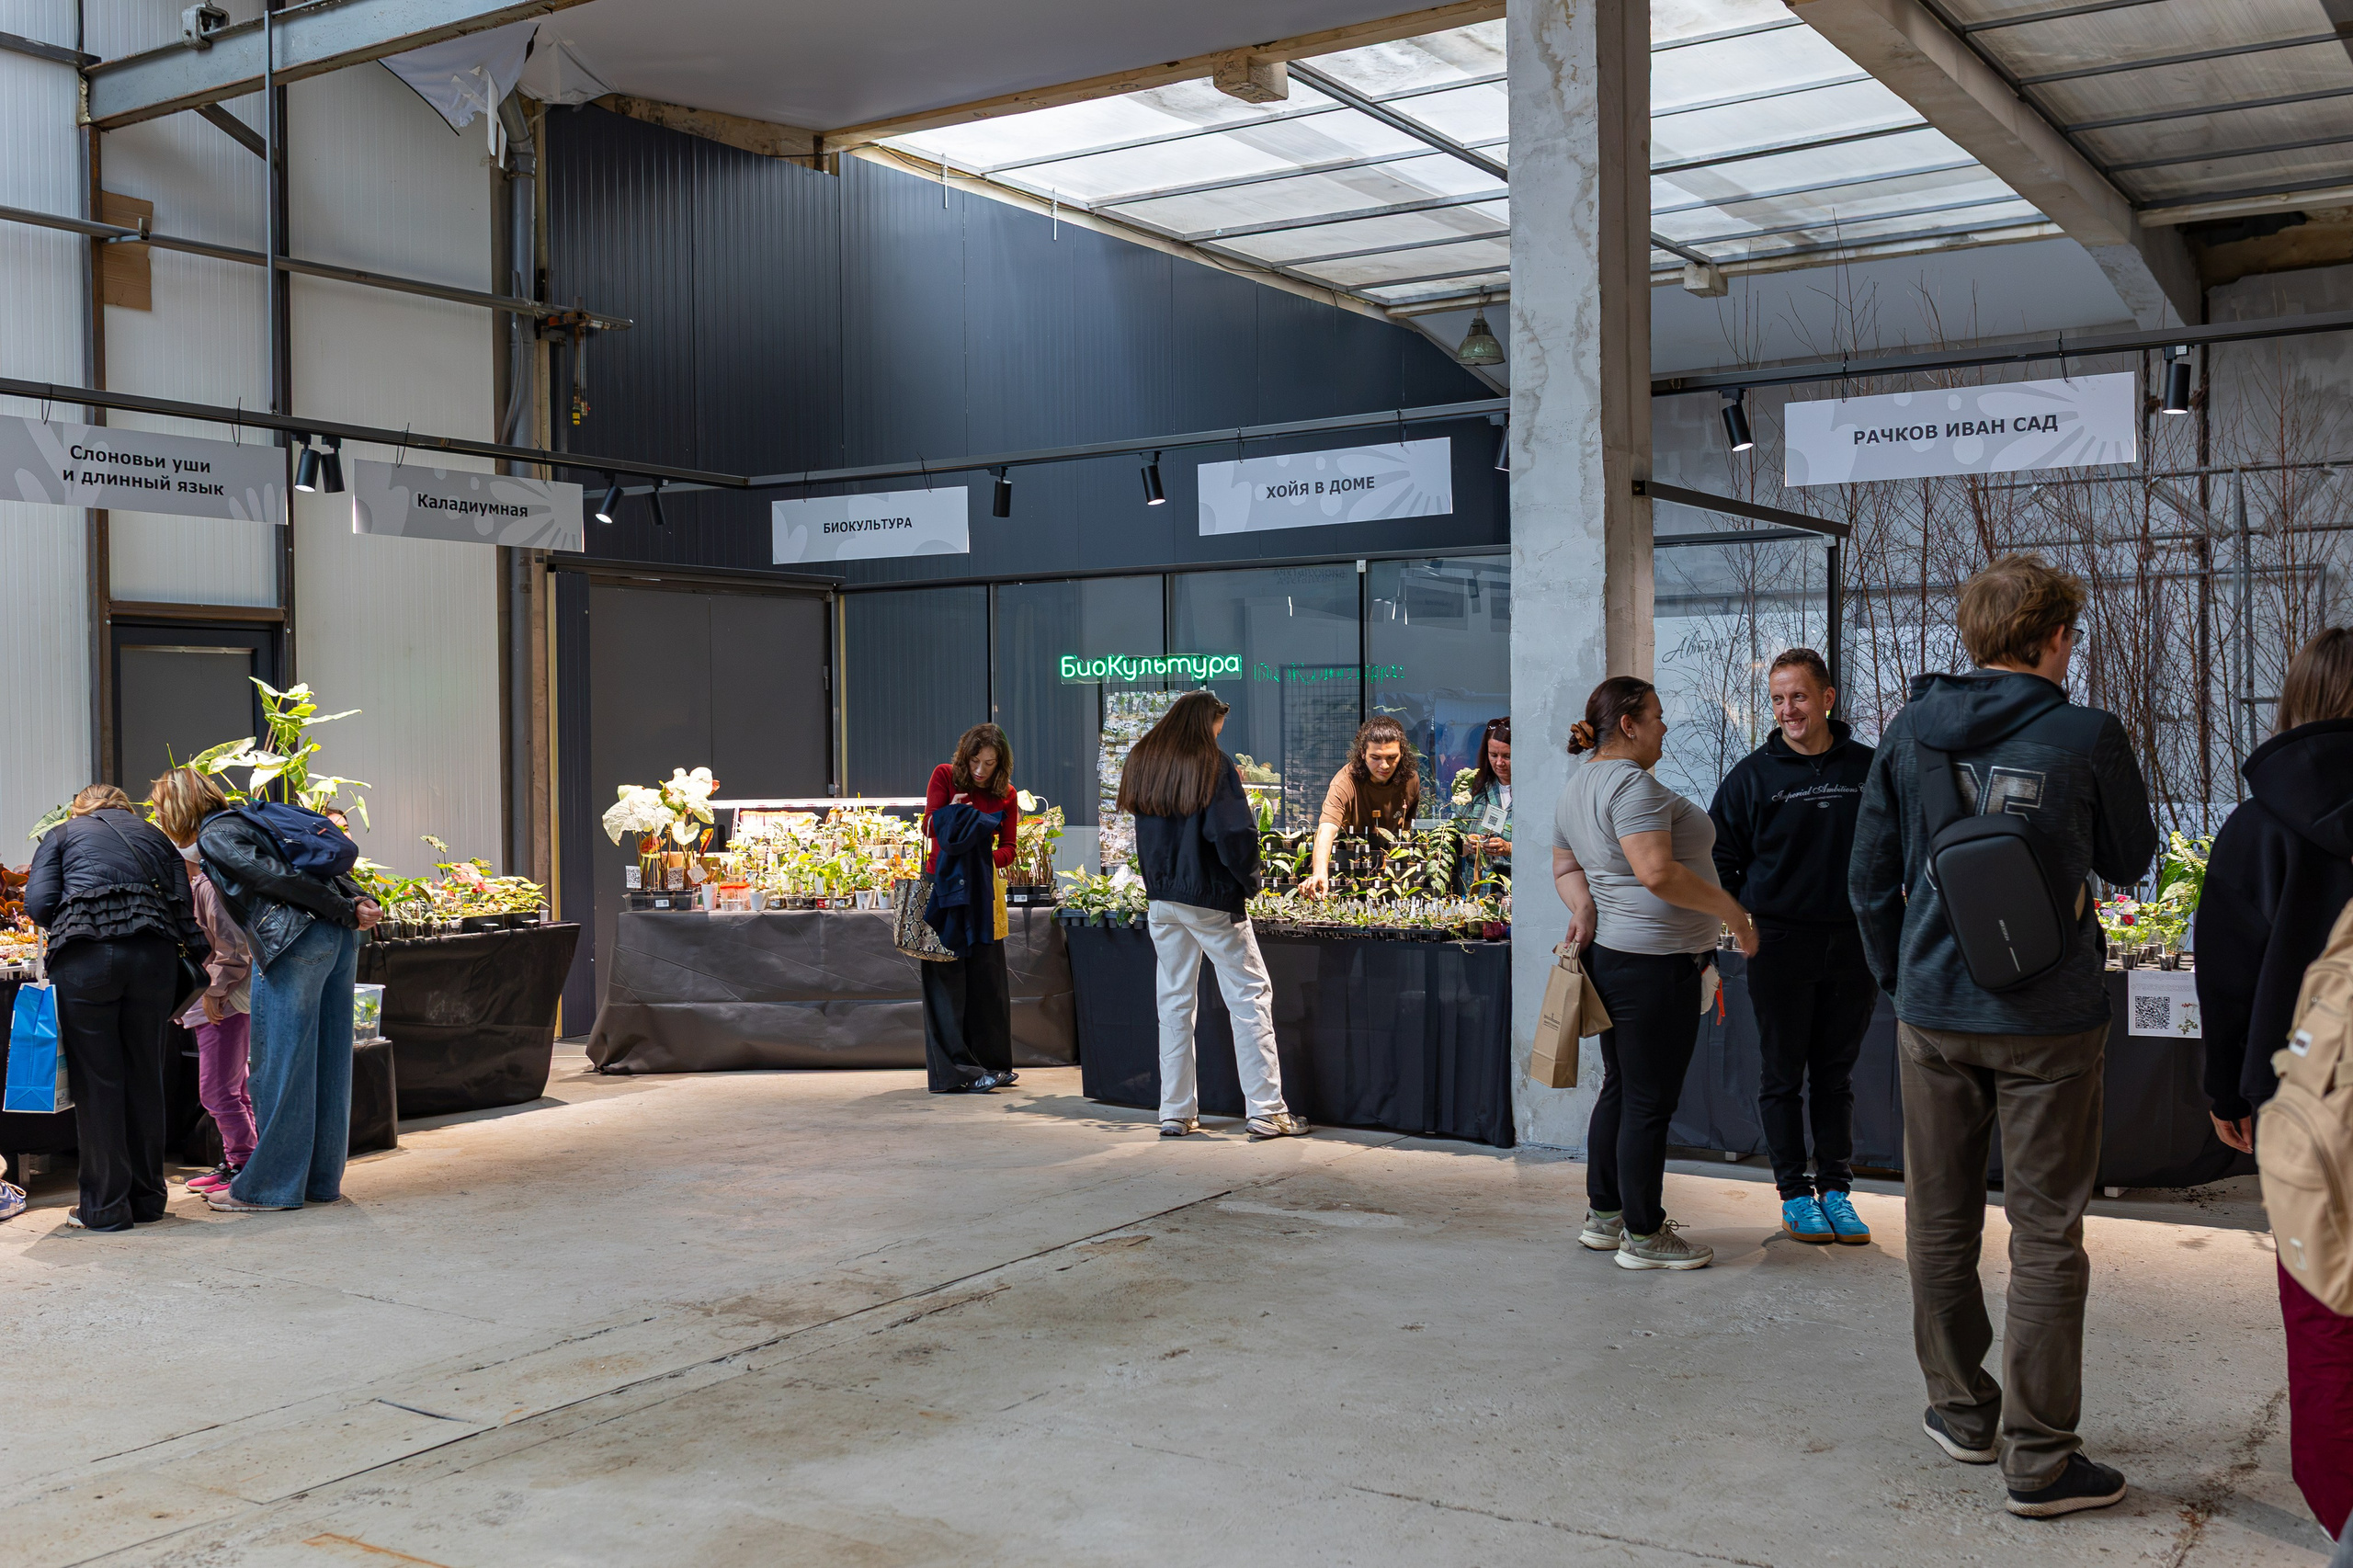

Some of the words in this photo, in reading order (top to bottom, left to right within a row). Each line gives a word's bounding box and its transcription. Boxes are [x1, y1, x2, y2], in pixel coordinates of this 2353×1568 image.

[1854, 425, 1938, 445] РАЧКОВ
[1946, 419, 2005, 438] ИВАН
[2013, 415, 2058, 433] САД
[70, 445, 165, 469] Слоновьи
[172, 458, 210, 473] уши
[63, 469, 74, 482] и
[81, 469, 171, 491] длинный
[177, 480, 224, 496] язык
[1267, 481, 1309, 499] ХОЙЯ
[1314, 482, 1324, 494] В
[1329, 476, 1375, 495] ДОМЕ
[417, 494, 529, 517] Каладиумная
[823, 517, 913, 534] БИОКУЛЬТУРА
[1061, 654, 1241, 682] БиоКультура
